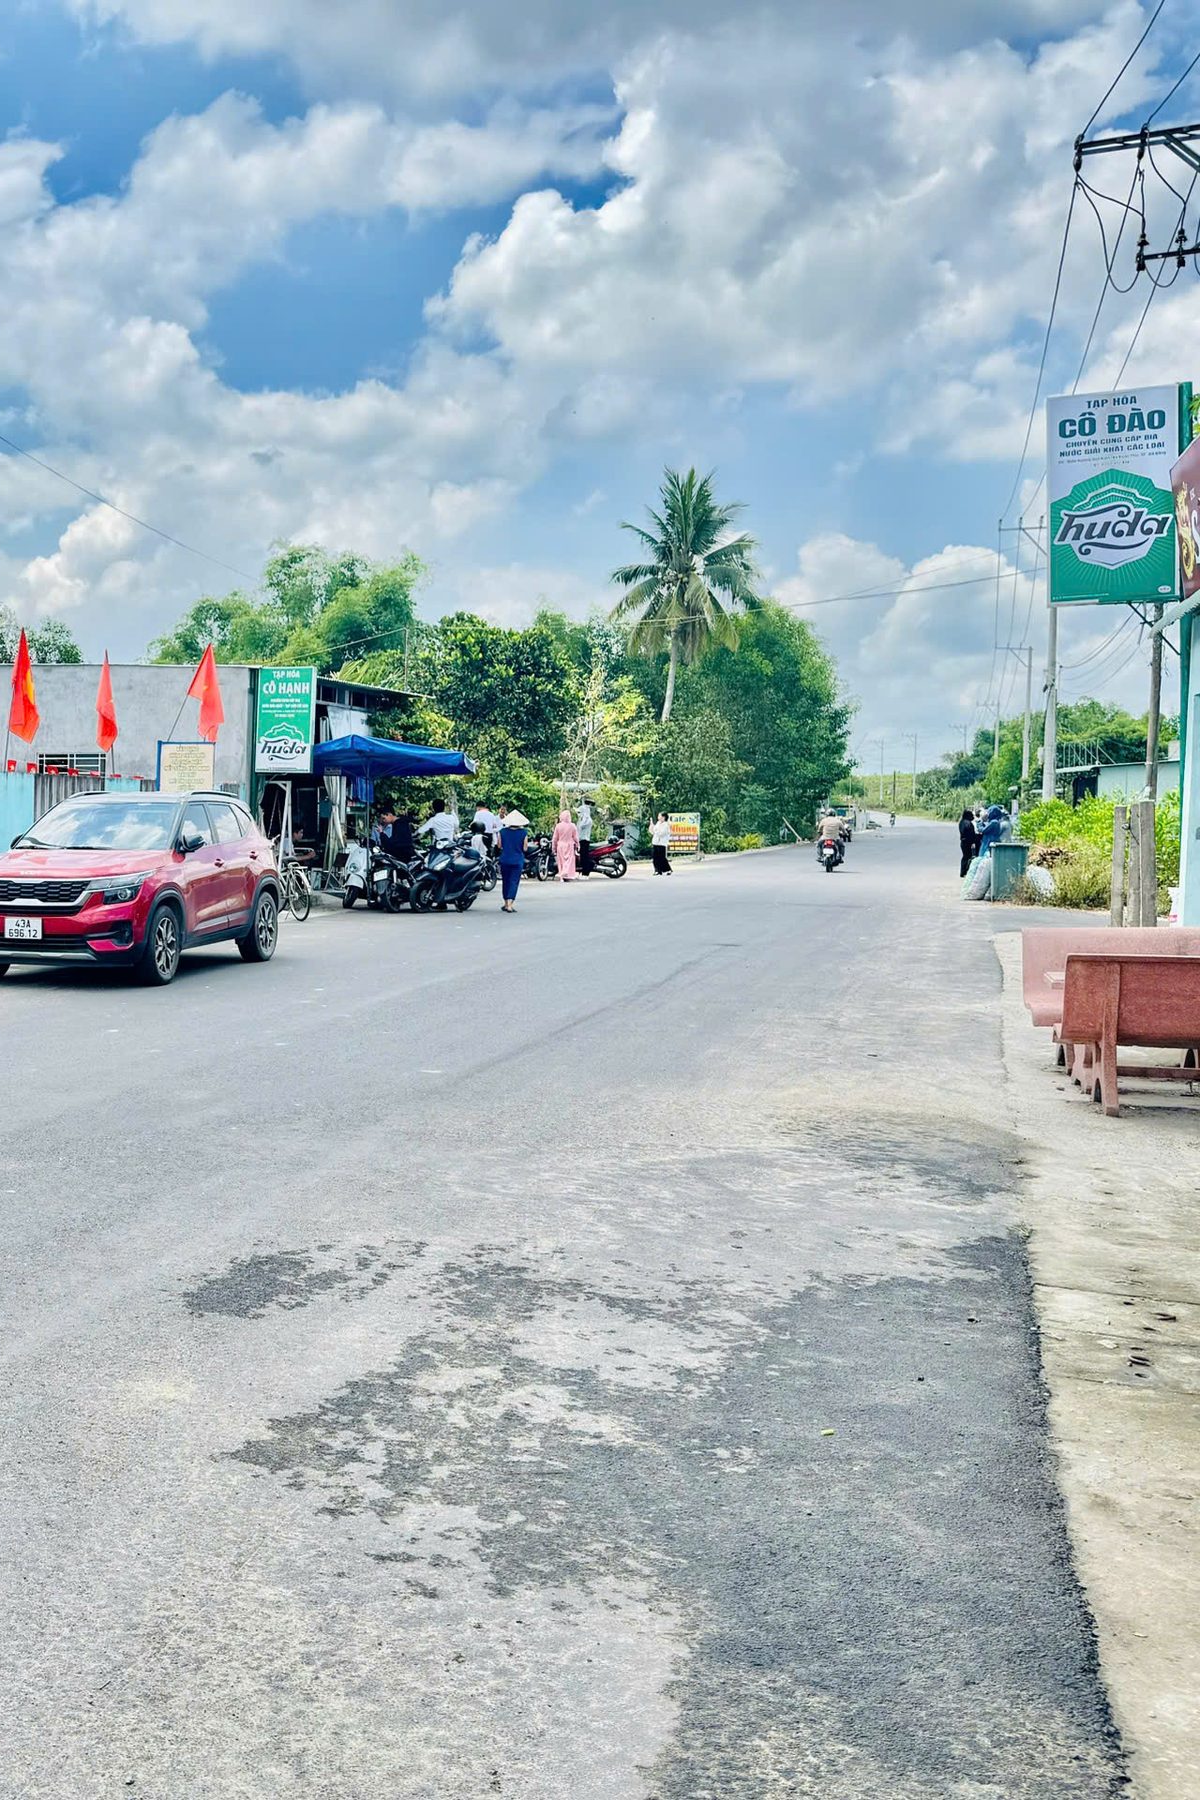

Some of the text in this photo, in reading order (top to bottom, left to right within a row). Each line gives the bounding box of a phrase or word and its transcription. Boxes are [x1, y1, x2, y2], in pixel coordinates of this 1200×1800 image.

[1086, 395, 1137, 410] TẠP HÓA
[1058, 407, 1166, 439] CÔ ĐÀO
[1100, 436, 1123, 445] CUNG
[1057, 504, 1170, 551] huda
[262, 680, 310, 697] CÔ HẠNH
[260, 738, 307, 759] huda
[15, 919, 31, 928] 43A
[8, 928, 38, 938] 696.12
